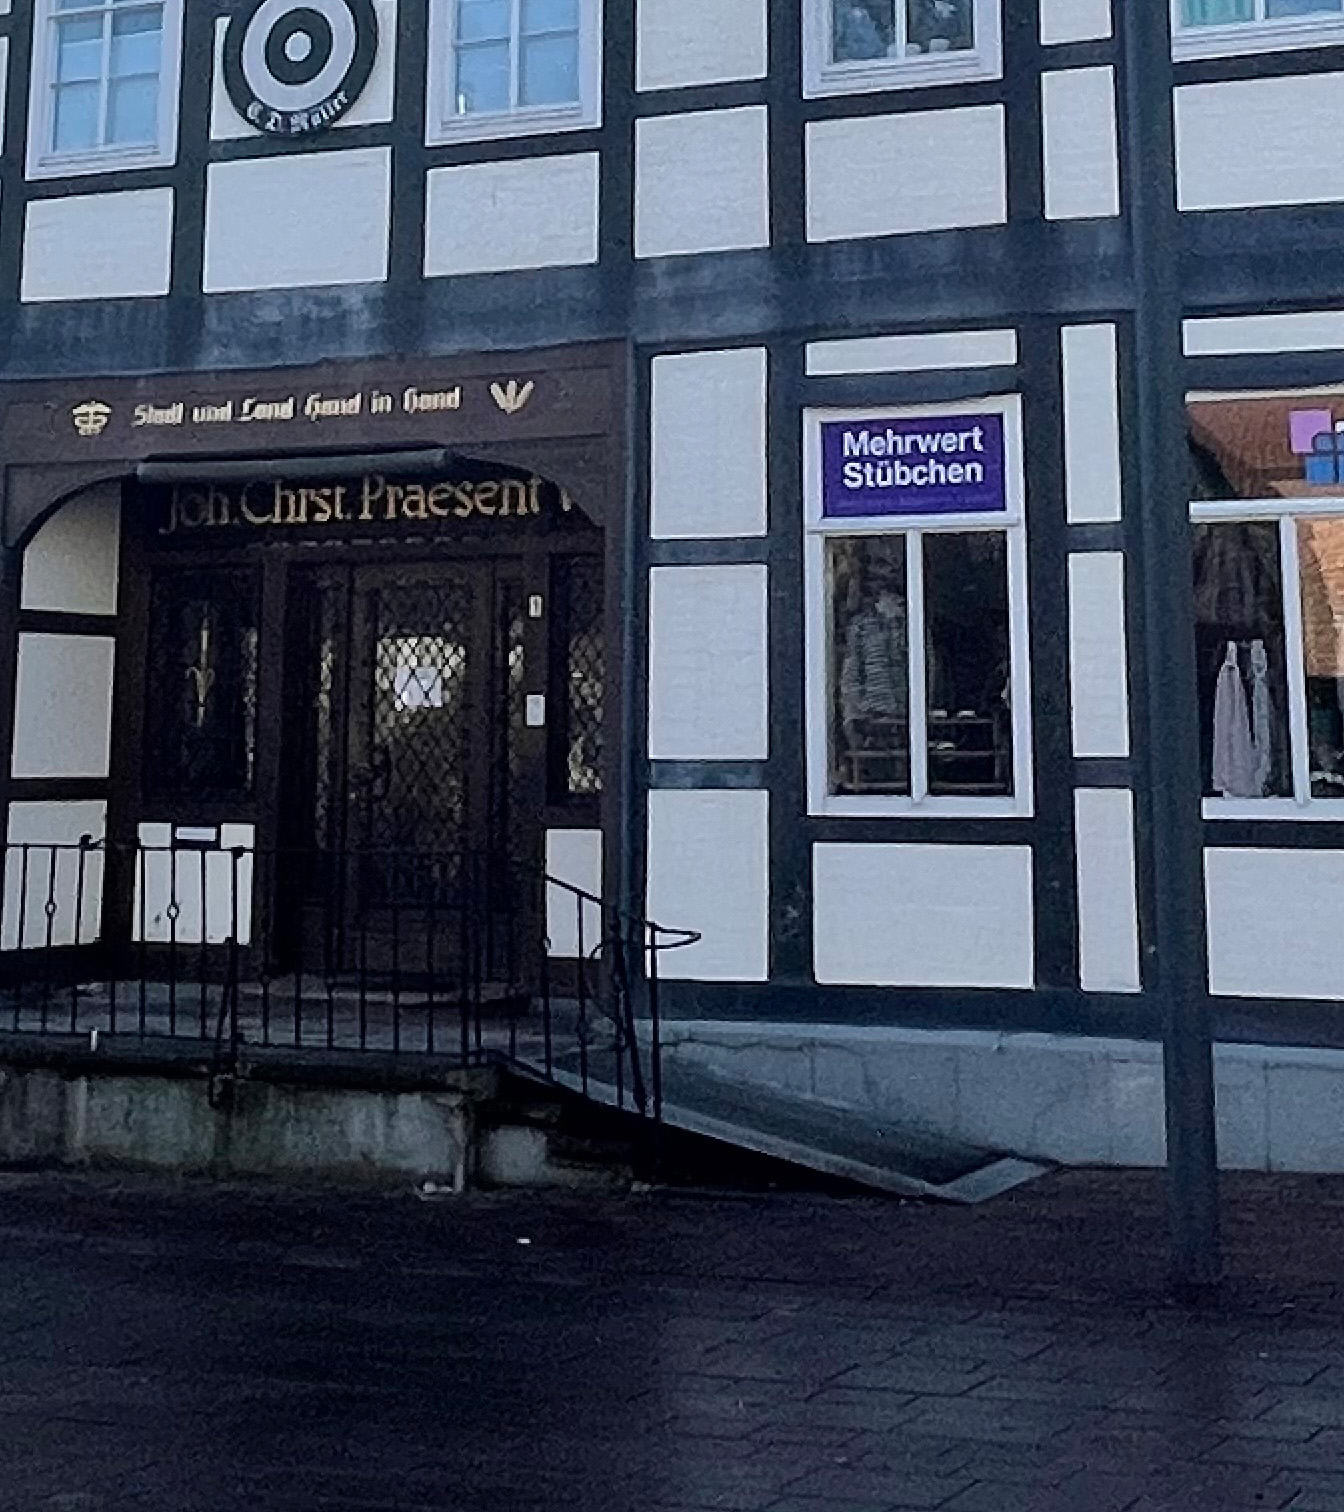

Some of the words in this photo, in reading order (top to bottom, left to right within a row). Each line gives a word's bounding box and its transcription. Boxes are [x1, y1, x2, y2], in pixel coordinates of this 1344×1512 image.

[369, 390, 393, 415] in
[842, 426, 984, 457] Mehrwert
[842, 458, 984, 489] Stübchen
[358, 473, 543, 520] Praesent
